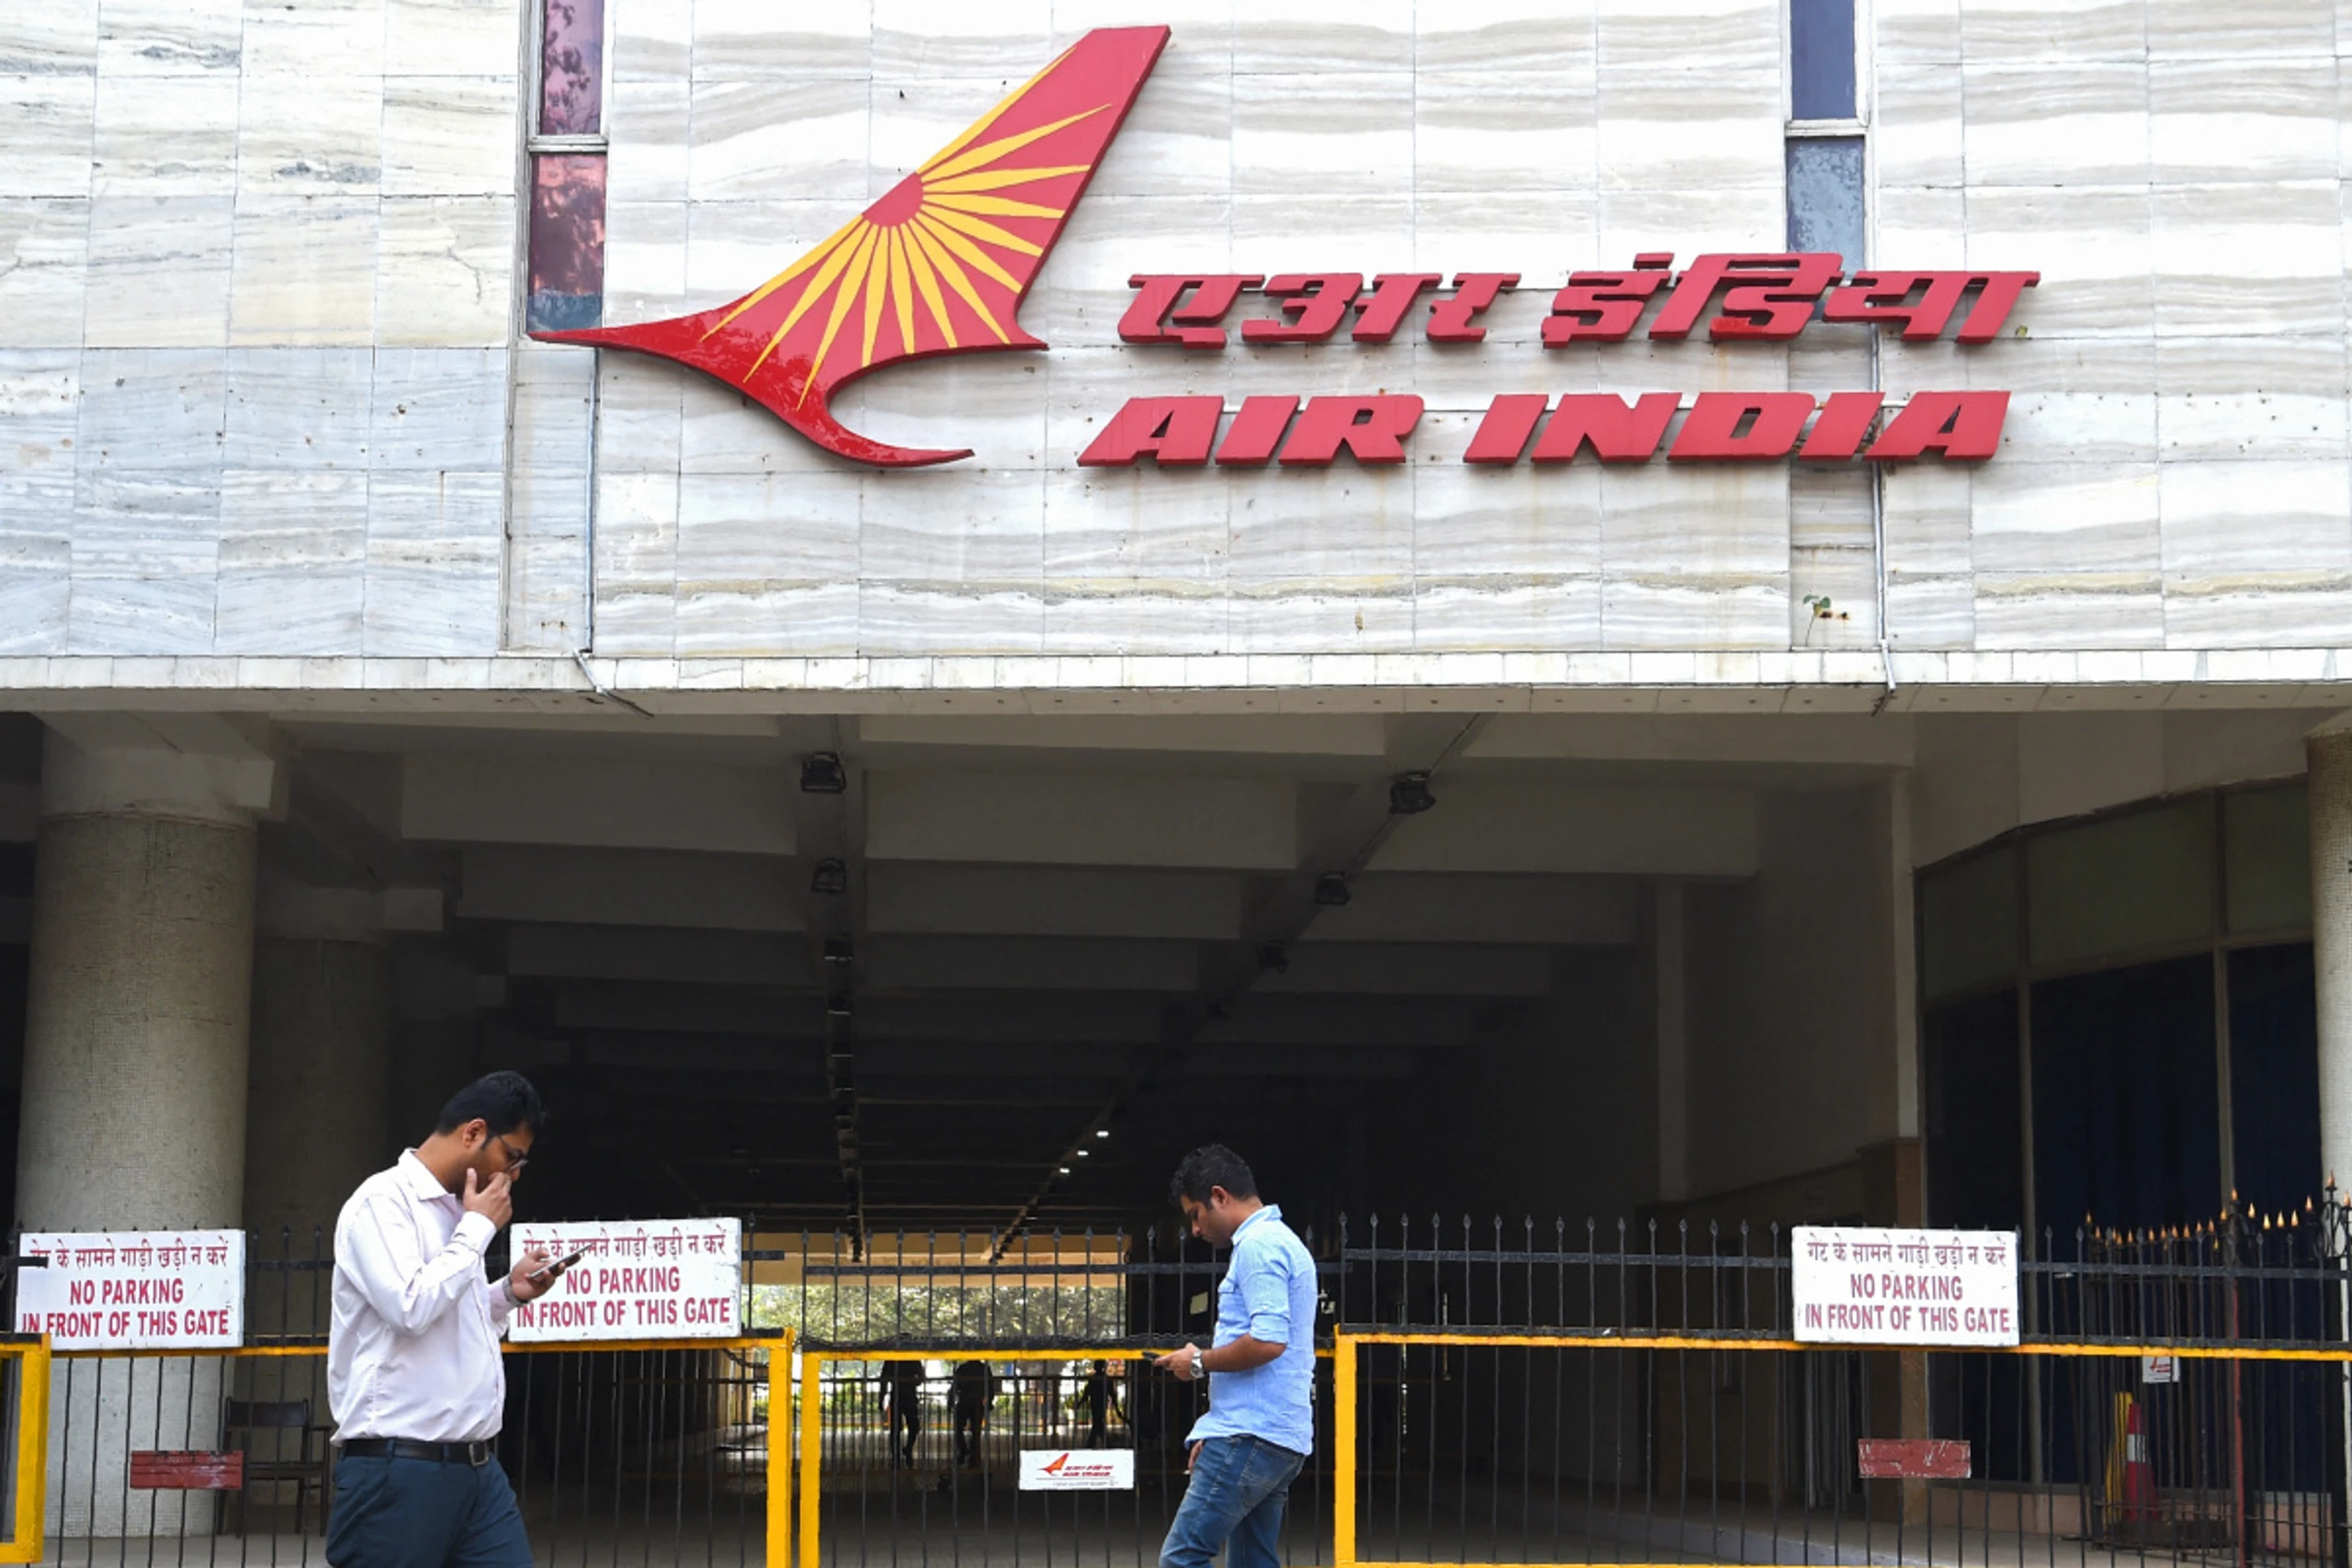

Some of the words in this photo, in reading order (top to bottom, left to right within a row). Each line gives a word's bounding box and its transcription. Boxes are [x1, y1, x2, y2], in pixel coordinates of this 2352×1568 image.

[1117, 273, 1521, 350] एअर
[1541, 252, 2041, 349] इंडिया
[1078, 395, 1425, 467] AIR
[1464, 390, 2012, 464] INDIA
[56, 1238, 69, 1268] के
[75, 1237, 116, 1269] सामने
[120, 1237, 153, 1271] गाड़ी
[157, 1237, 187, 1271] खड़ी
[190, 1246, 202, 1266] न
[206, 1235, 229, 1268] करें
[549, 1229, 564, 1258] के
[614, 1227, 648, 1261] गाड़ी
[653, 1226, 684, 1261] खड़ी
[687, 1235, 699, 1254] न
[703, 1224, 727, 1256] करें
[1807, 1232, 1828, 1262] गेट
[1832, 1233, 1847, 1261] के
[1851, 1234, 1893, 1264] सामने
[1897, 1236, 1929, 1269] गाड़ी
[1933, 1236, 1963, 1269] खड़ी
[1967, 1246, 1979, 1264] न
[1984, 1236, 2007, 1267] करें
[70, 1280, 96, 1305] NO
[102, 1278, 184, 1304] PARKING
[566, 1269, 592, 1294] NO
[600, 1266, 681, 1294] PARKING
[1850, 1273, 1875, 1298] NO
[1882, 1274, 1963, 1300] PARKING
[22, 1313, 40, 1332] IN
[46, 1312, 103, 1337] FRONT
[108, 1311, 130, 1337] OF
[137, 1310, 177, 1337] THIS
[185, 1309, 229, 1336] GATE
[517, 1304, 534, 1327] IN
[539, 1300, 596, 1327] FRONT
[604, 1300, 626, 1325] OF
[635, 1299, 677, 1325] THIS
[684, 1297, 730, 1324] GATE
[1805, 1303, 1822, 1328] IN
[1827, 1304, 1884, 1329] FRONT
[1890, 1305, 1912, 1330] OF
[1918, 1306, 1959, 1332] THIS
[1964, 1307, 2010, 1333] GATE
